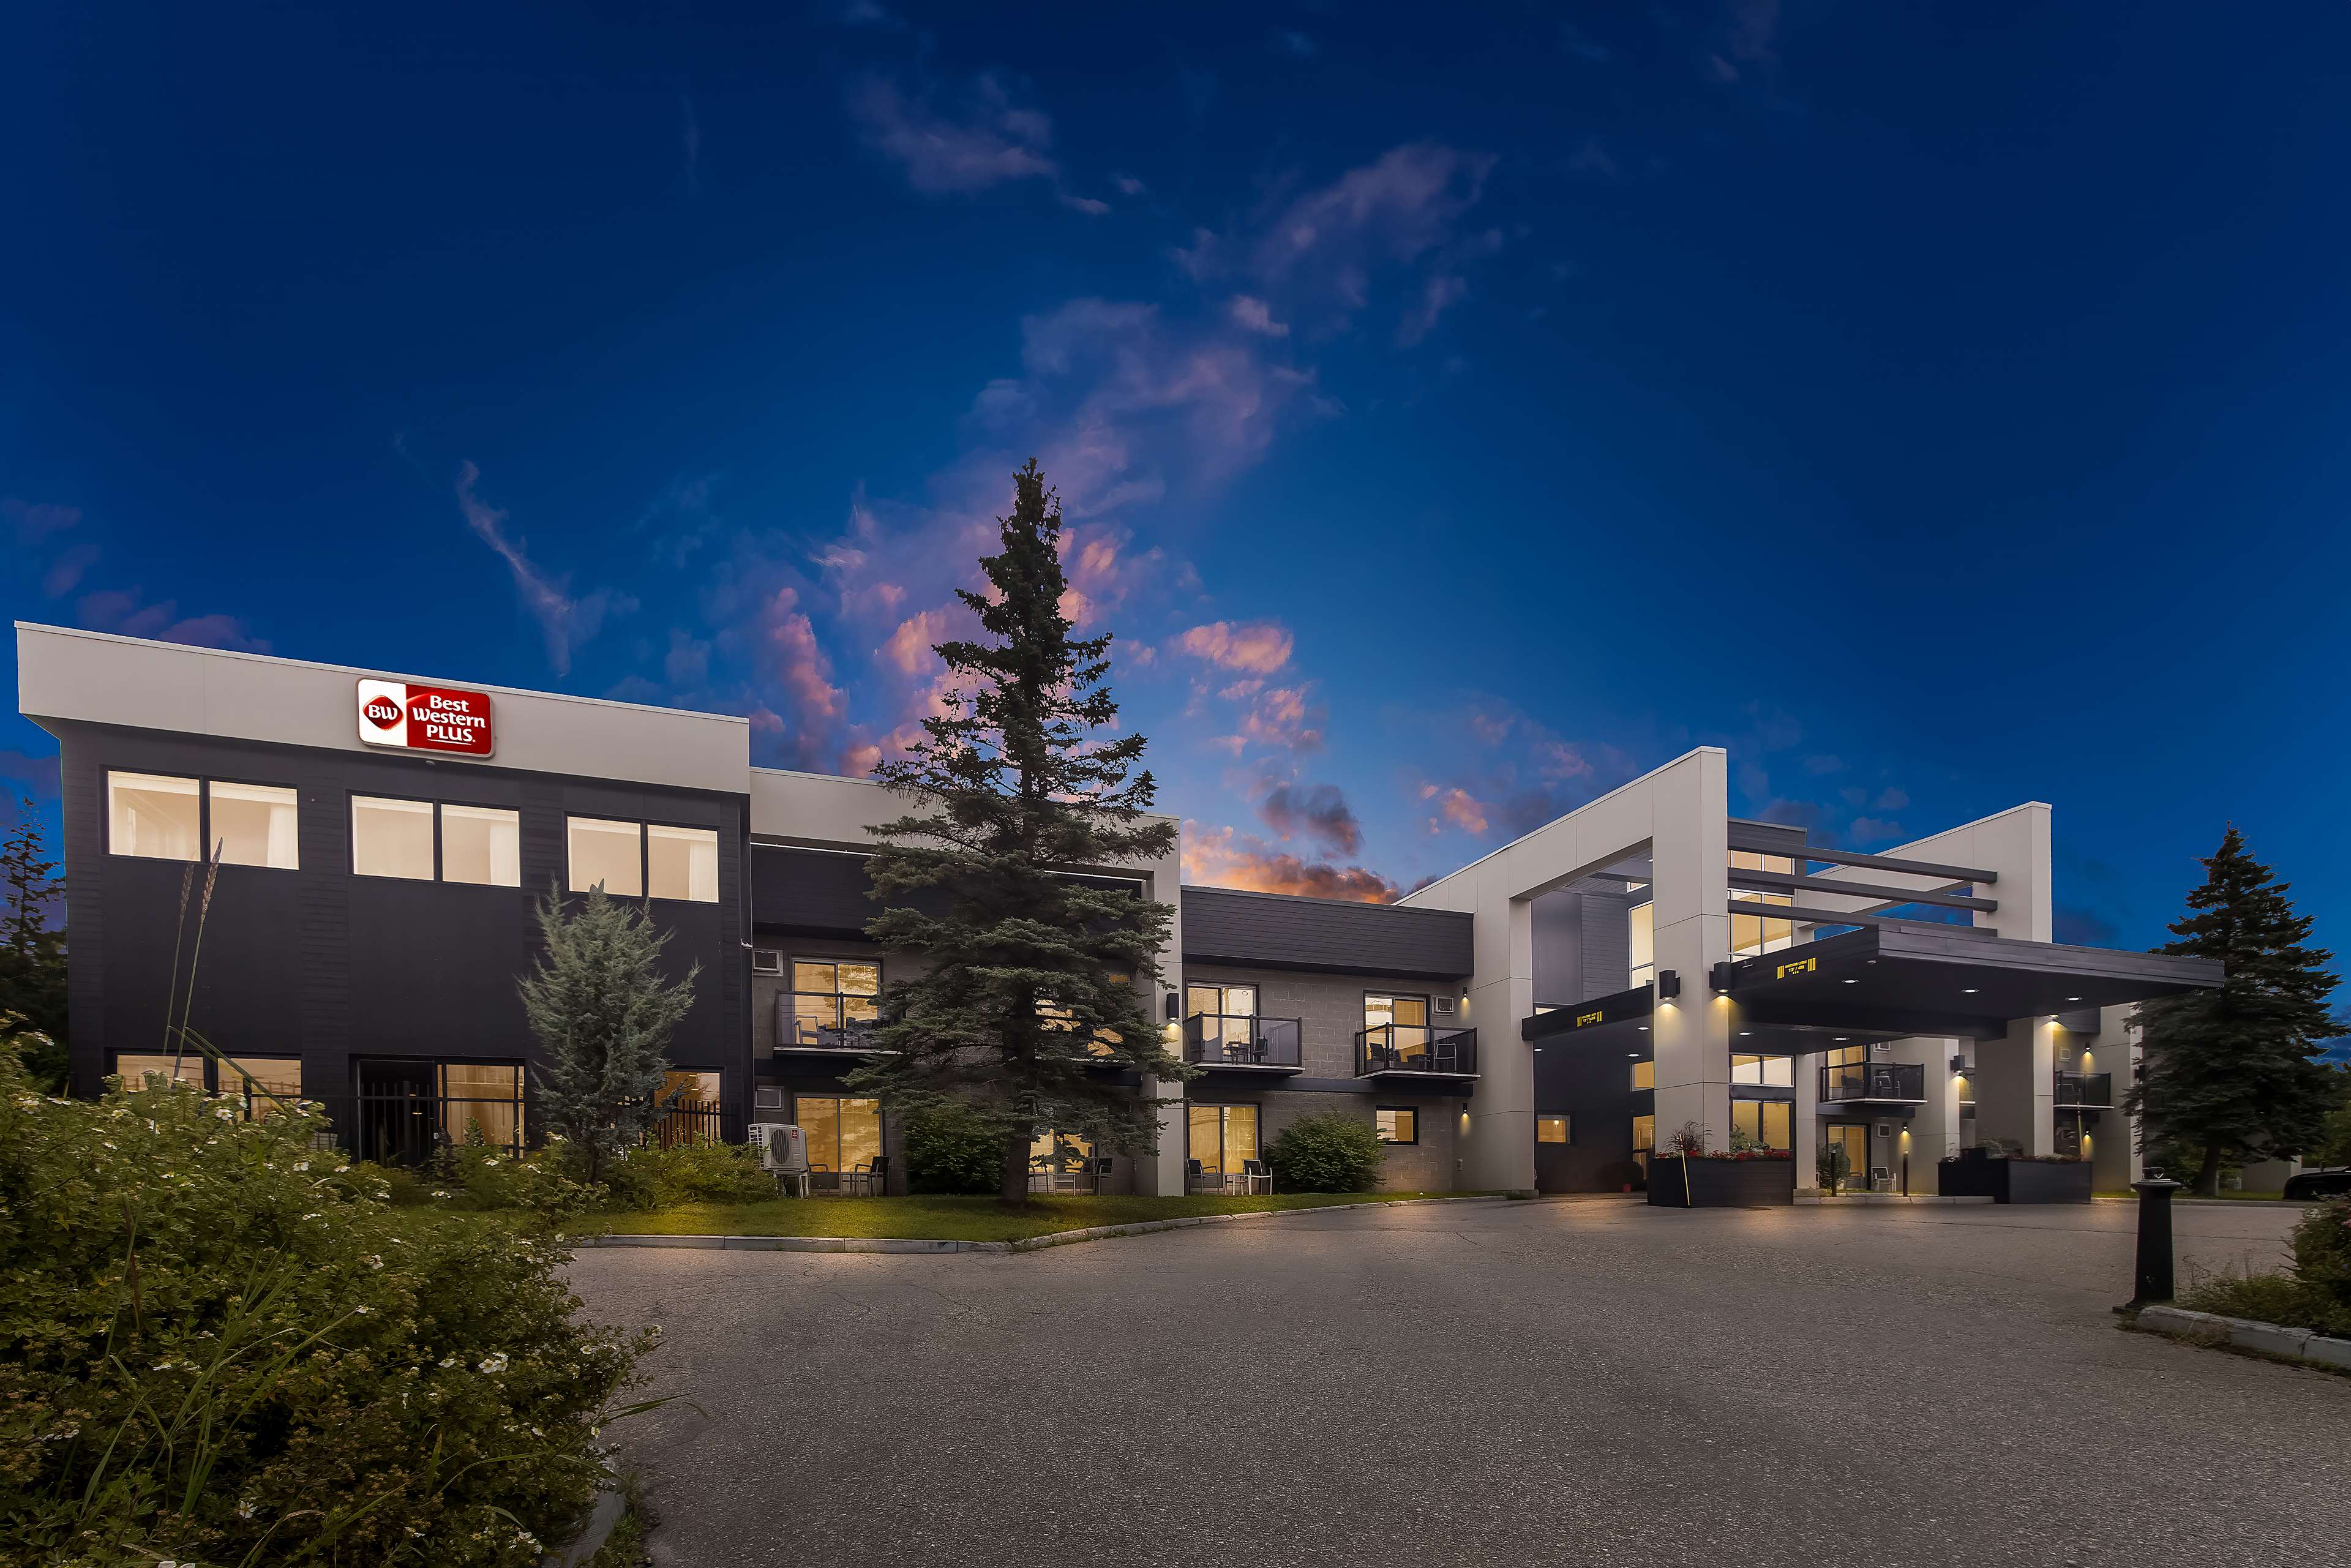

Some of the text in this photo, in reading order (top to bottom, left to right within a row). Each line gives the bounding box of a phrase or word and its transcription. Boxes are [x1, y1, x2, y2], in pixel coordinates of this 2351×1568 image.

[430, 695, 470, 712] Best
[369, 705, 398, 720] BW
[413, 707, 486, 728] Western
[427, 724, 473, 742] PLUS
